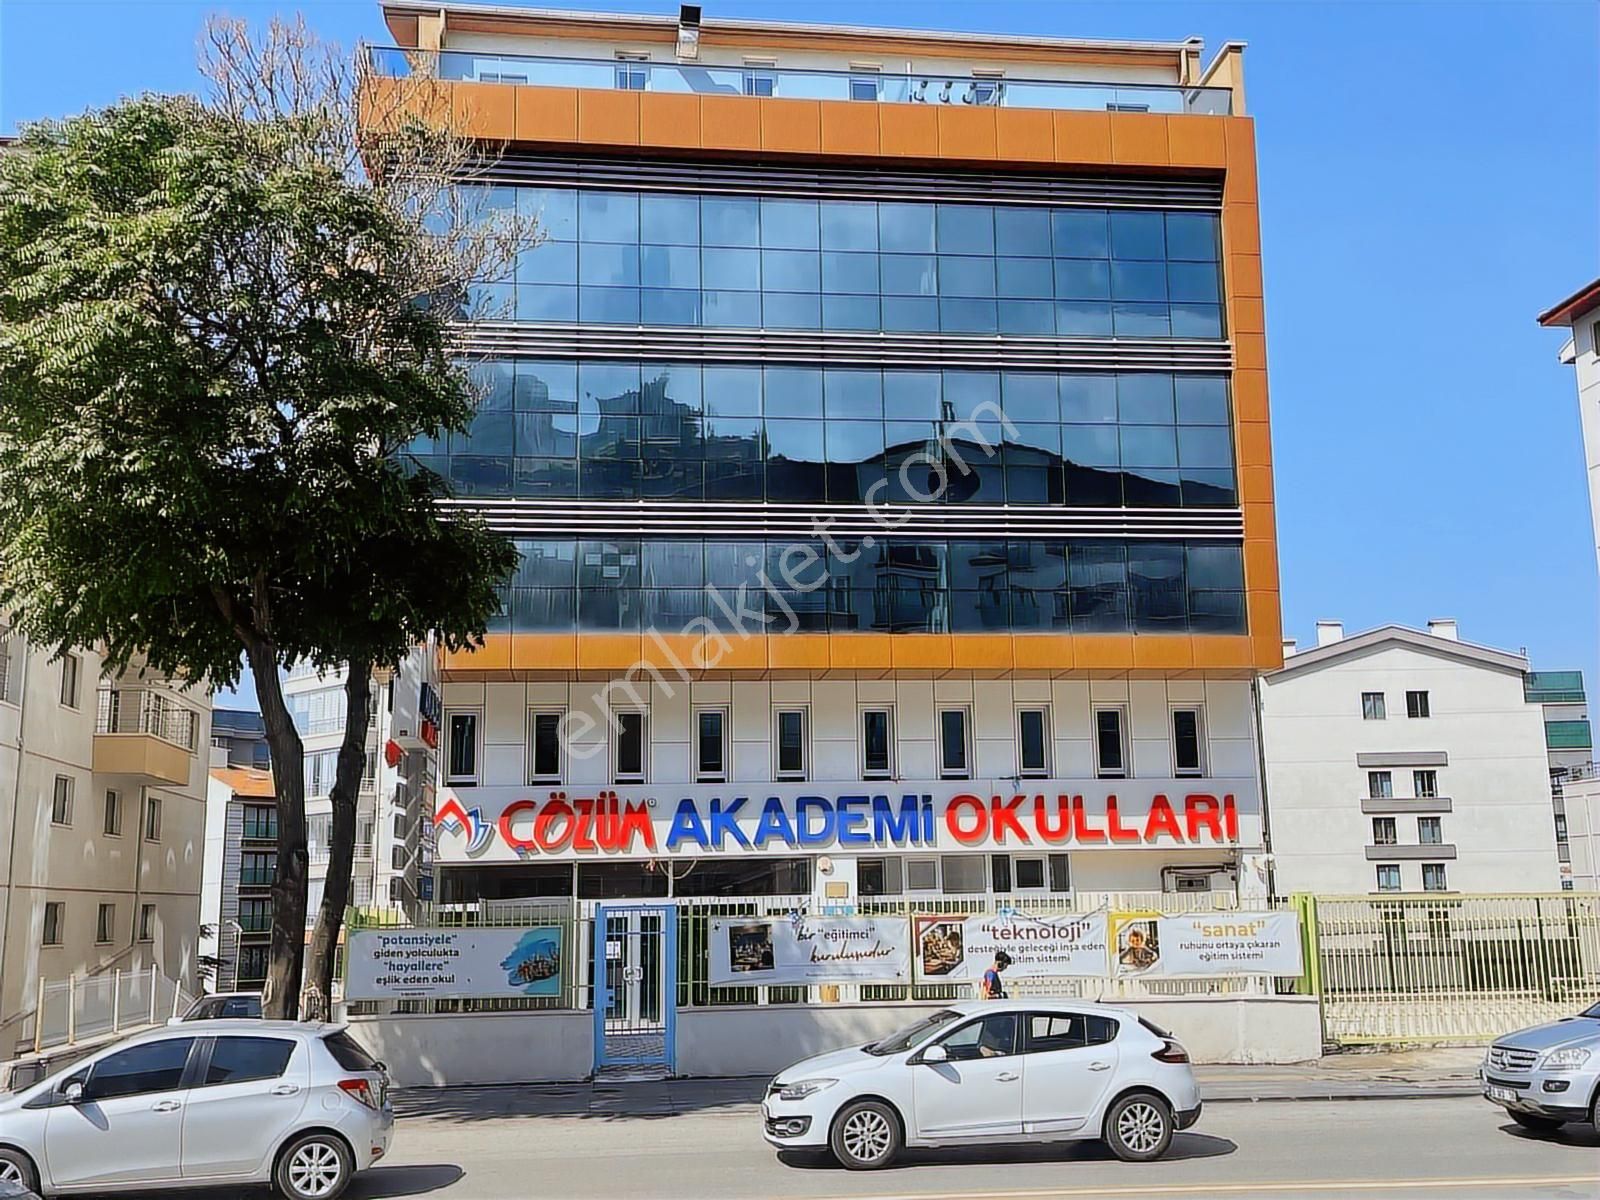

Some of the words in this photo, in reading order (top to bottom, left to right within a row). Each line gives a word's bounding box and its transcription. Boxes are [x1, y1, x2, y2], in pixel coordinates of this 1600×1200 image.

[500, 791, 656, 858] ÇÖZÜM
[945, 793, 1239, 845] OKULLARI
[796, 925, 816, 941] bir
[1018, 943, 1058, 954] geleceği
[1081, 942, 1105, 951] eden
[1180, 942, 1214, 950] ruhunu
[1216, 941, 1245, 951] ortaya
[1247, 940, 1280, 951] çıkaran
[374, 948, 403, 959] giden
[405, 948, 459, 959] yolculukta
[1036, 953, 1071, 963] sistemi
[1199, 951, 1230, 962] eğitim
[1231, 951, 1264, 960] sistemi
[376, 974, 400, 986] eşlik
[403, 974, 429, 984] eden
[431, 974, 455, 984] okul
